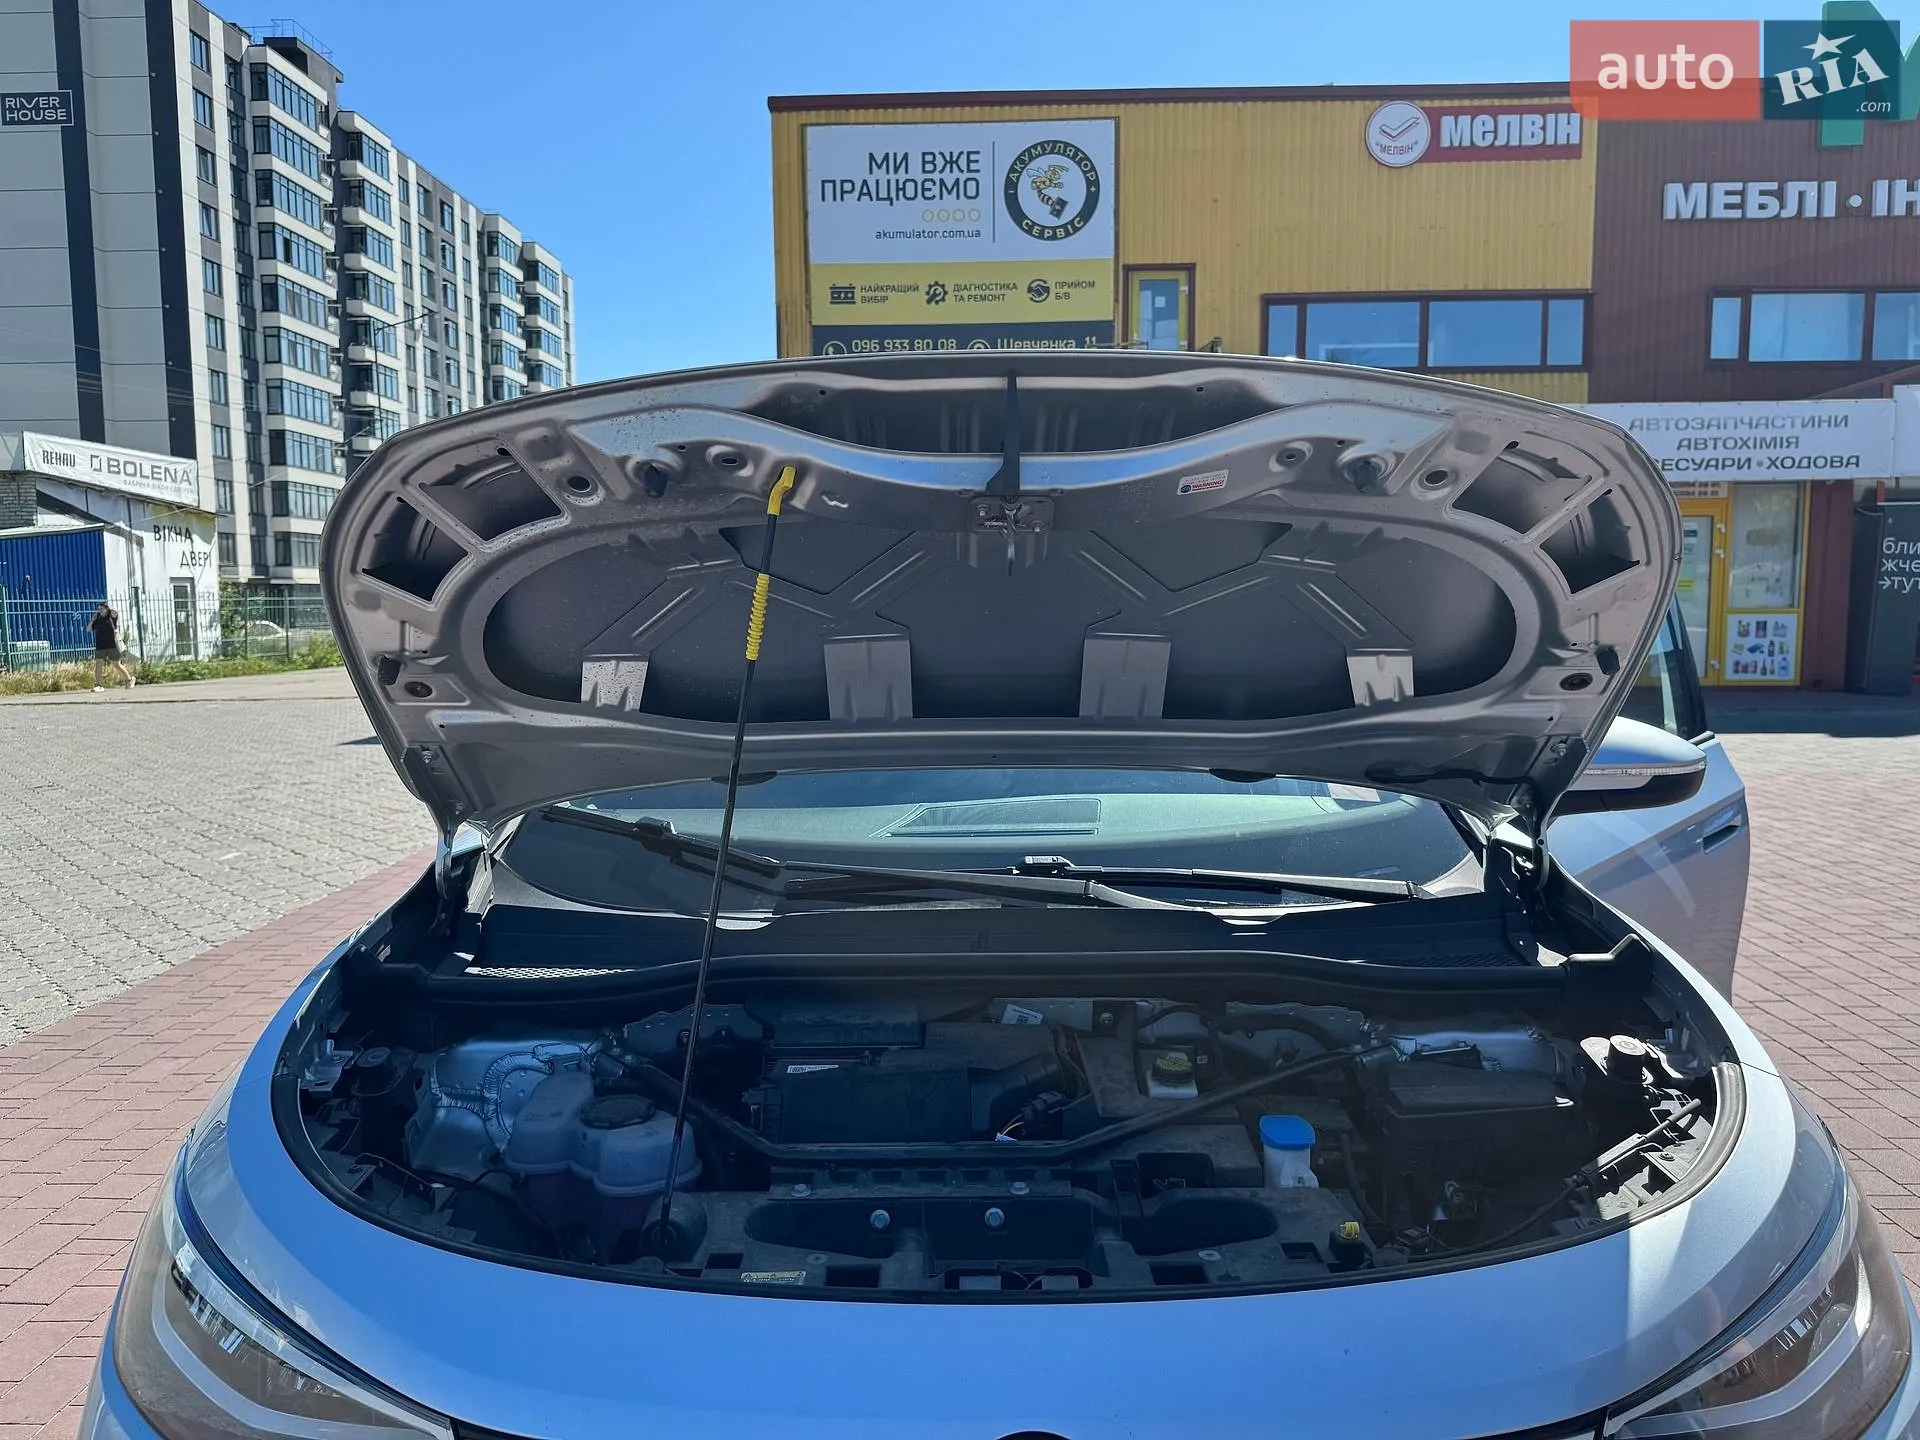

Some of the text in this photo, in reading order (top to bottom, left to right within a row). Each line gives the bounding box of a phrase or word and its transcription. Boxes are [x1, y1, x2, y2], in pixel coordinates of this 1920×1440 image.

[5, 96, 60, 109] RIVER
[6, 109, 67, 121] HOUSE
[868, 150, 981, 175] МИ ВЖЕ
[1009, 142, 1097, 183] АКУМУЛЯТОР
[820, 177, 980, 206] ПРАЦЮЄМО
[1662, 181, 1837, 221] МЕБЛІ
[875, 228, 982, 240] akumulator.com.ua
[1022, 216, 1084, 239] СЕРВІС
[860, 284, 920, 294] НАЙКРАЩИЙ
[953, 282, 1018, 293] ДІАГНОСТИКА
[1054, 280, 1096, 291] ПРИЙОМ
[860, 296, 889, 305] ВИБІР
[953, 293, 1008, 304] ТА РЕМОНТ
[1054, 292, 1071, 301] Б/В
[852, 338, 957, 352] 096 933 80 08
[1628, 414, 1850, 433] АВТОЗАПЧАСТИНИ
[1676, 436, 1801, 451] АВТОХІМІЯ
[42, 450, 76, 468] REHAU
[1653, 454, 1861, 472] ЕСУАРИ ХОДОВА
[106, 457, 193, 486] BOLENA
[153, 524, 194, 543] ВІКНА
[1882, 537, 1920, 555] бли
[180, 550, 212, 569] ДВЕРІ
